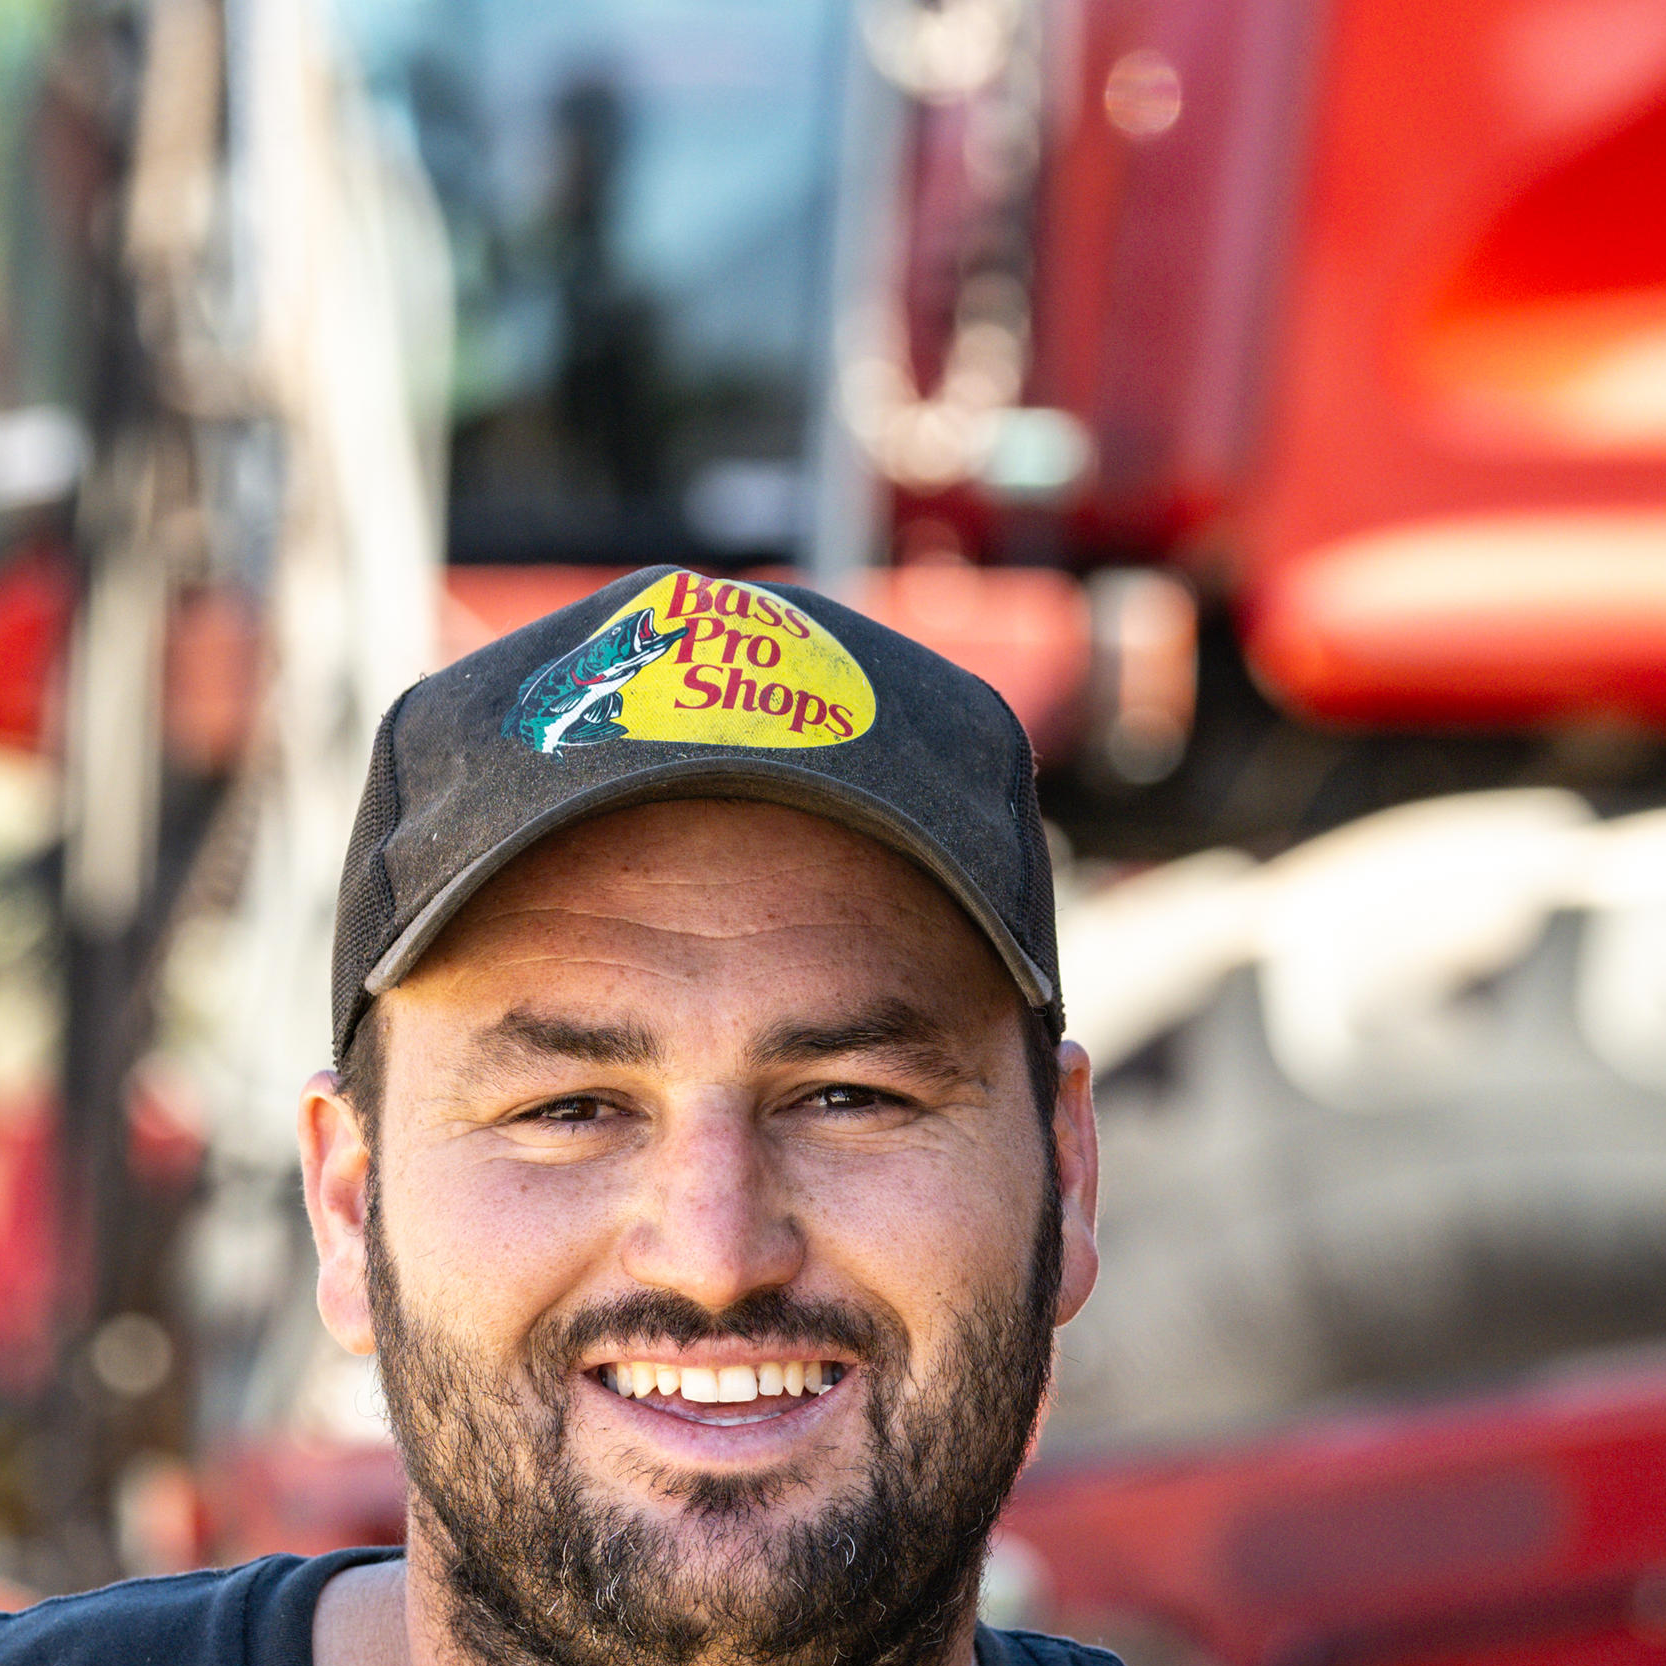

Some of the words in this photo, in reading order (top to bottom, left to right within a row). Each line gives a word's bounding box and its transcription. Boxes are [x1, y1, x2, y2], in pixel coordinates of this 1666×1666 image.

[665, 573, 810, 639] Bass
[674, 617, 781, 668] Pro
[674, 664, 854, 737] Shops
